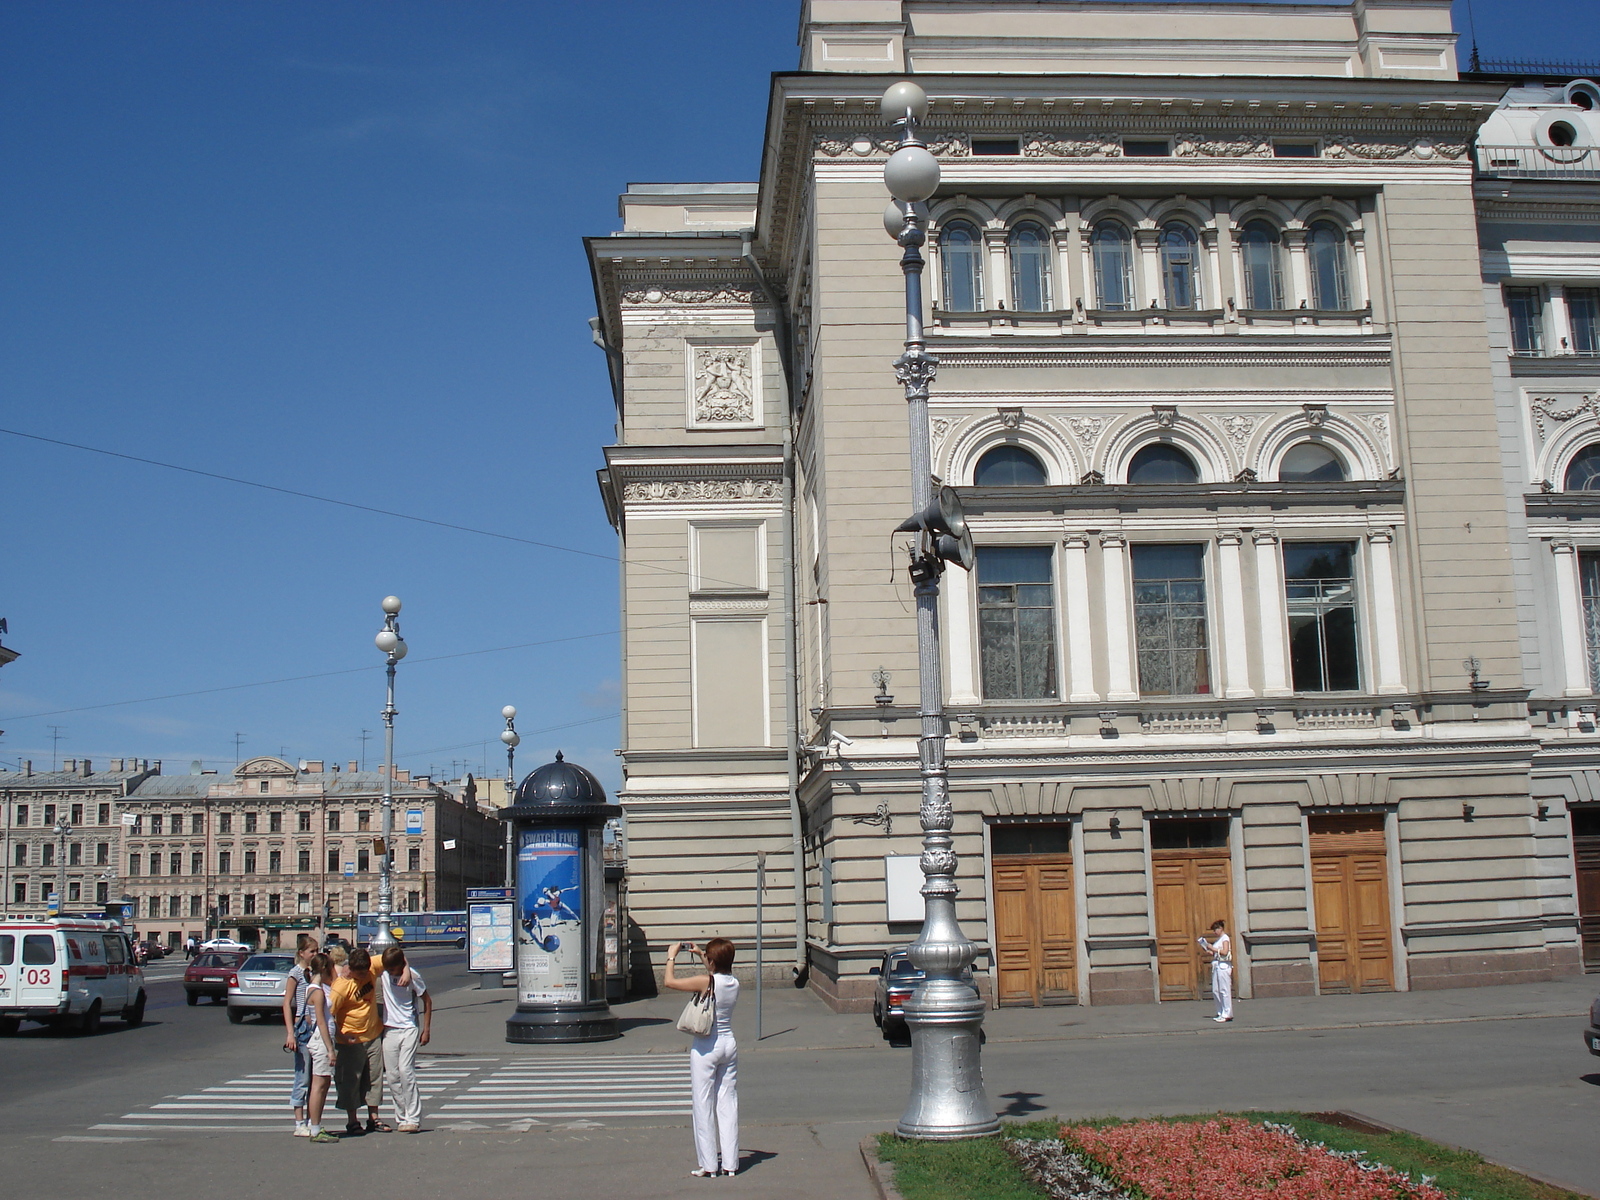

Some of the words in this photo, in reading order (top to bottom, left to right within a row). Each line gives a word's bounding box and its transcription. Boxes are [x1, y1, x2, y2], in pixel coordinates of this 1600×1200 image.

[525, 832, 557, 844] SWATCH
[559, 832, 579, 843] FIVB
[88, 941, 98, 956] 03
[27, 969, 51, 985] 03
